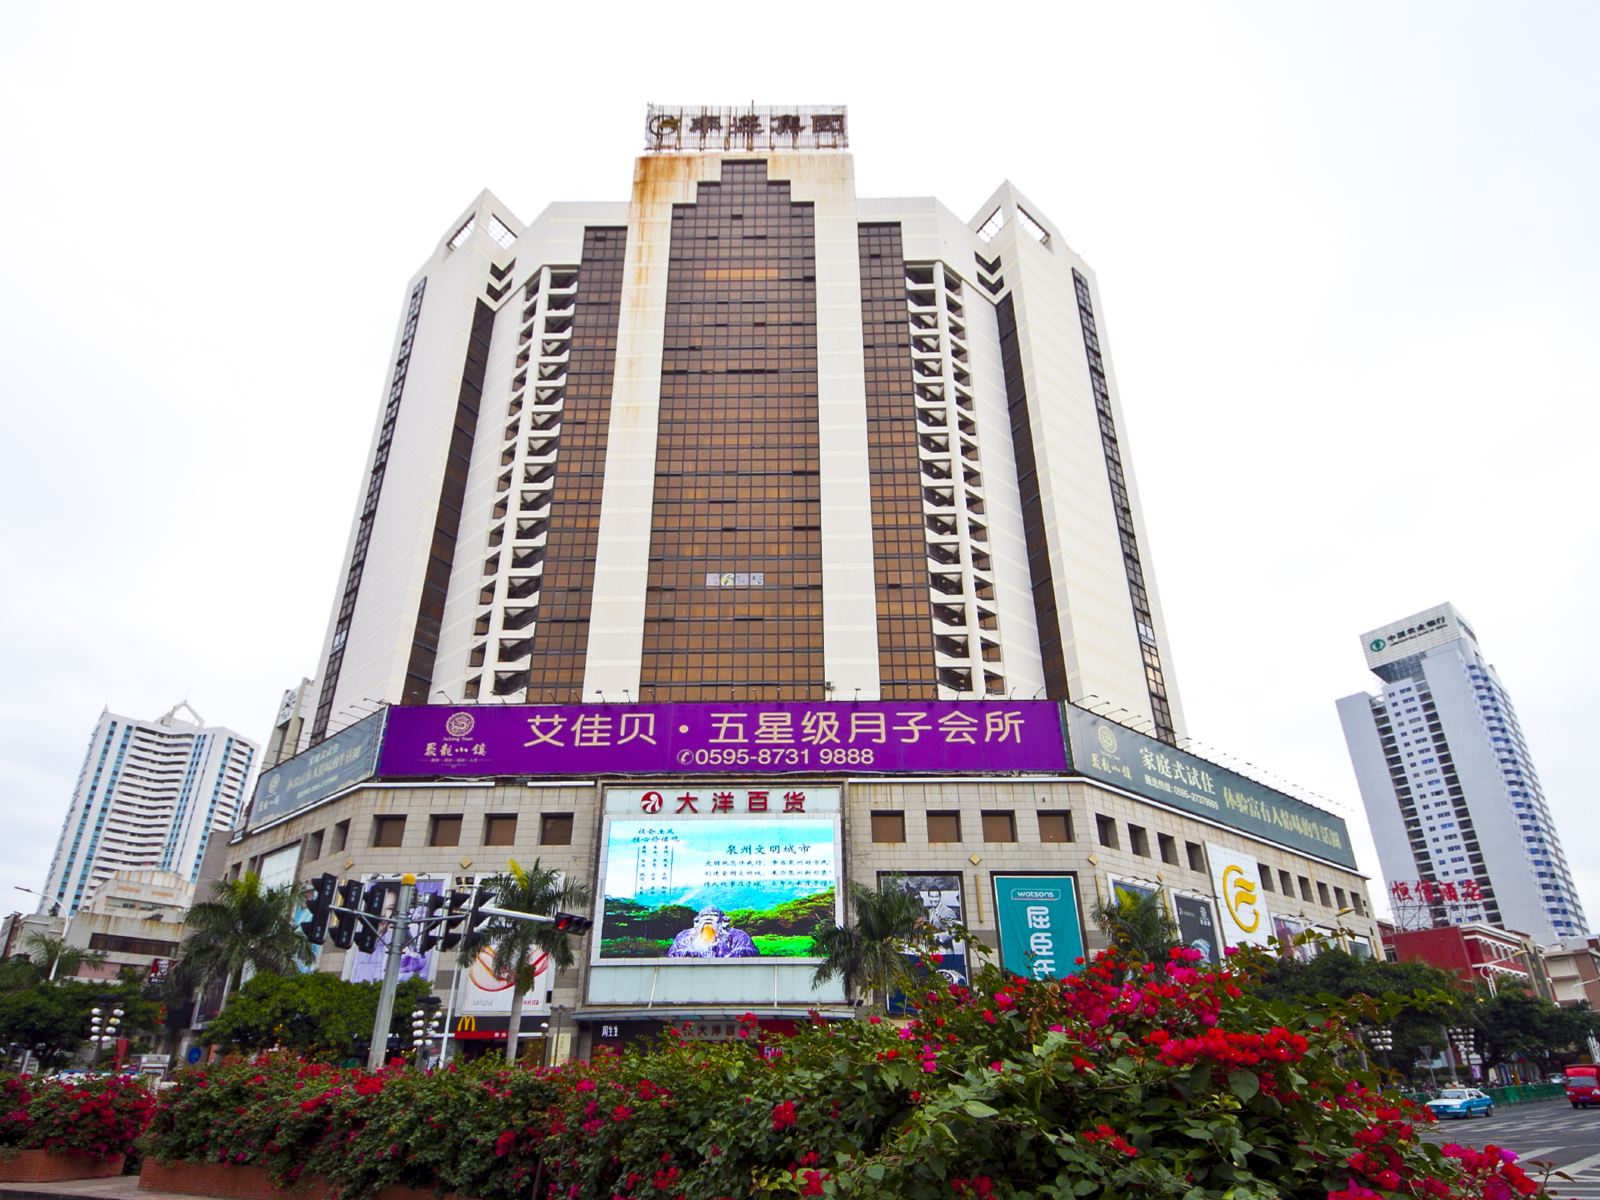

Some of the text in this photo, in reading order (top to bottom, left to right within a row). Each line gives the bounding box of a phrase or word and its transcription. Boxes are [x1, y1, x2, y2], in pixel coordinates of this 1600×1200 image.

[523, 711, 1025, 748] 艾佳贝·五星级月子会所
[694, 748, 874, 765] 0595-8731 9888
[1139, 747, 1216, 795] 家庭式试住
[676, 791, 806, 814] 大洋百货
[726, 844, 811, 855] 泉州文明城市
[1017, 890, 1055, 899] watsons
[1026, 905, 1057, 981] 屈臣氏
